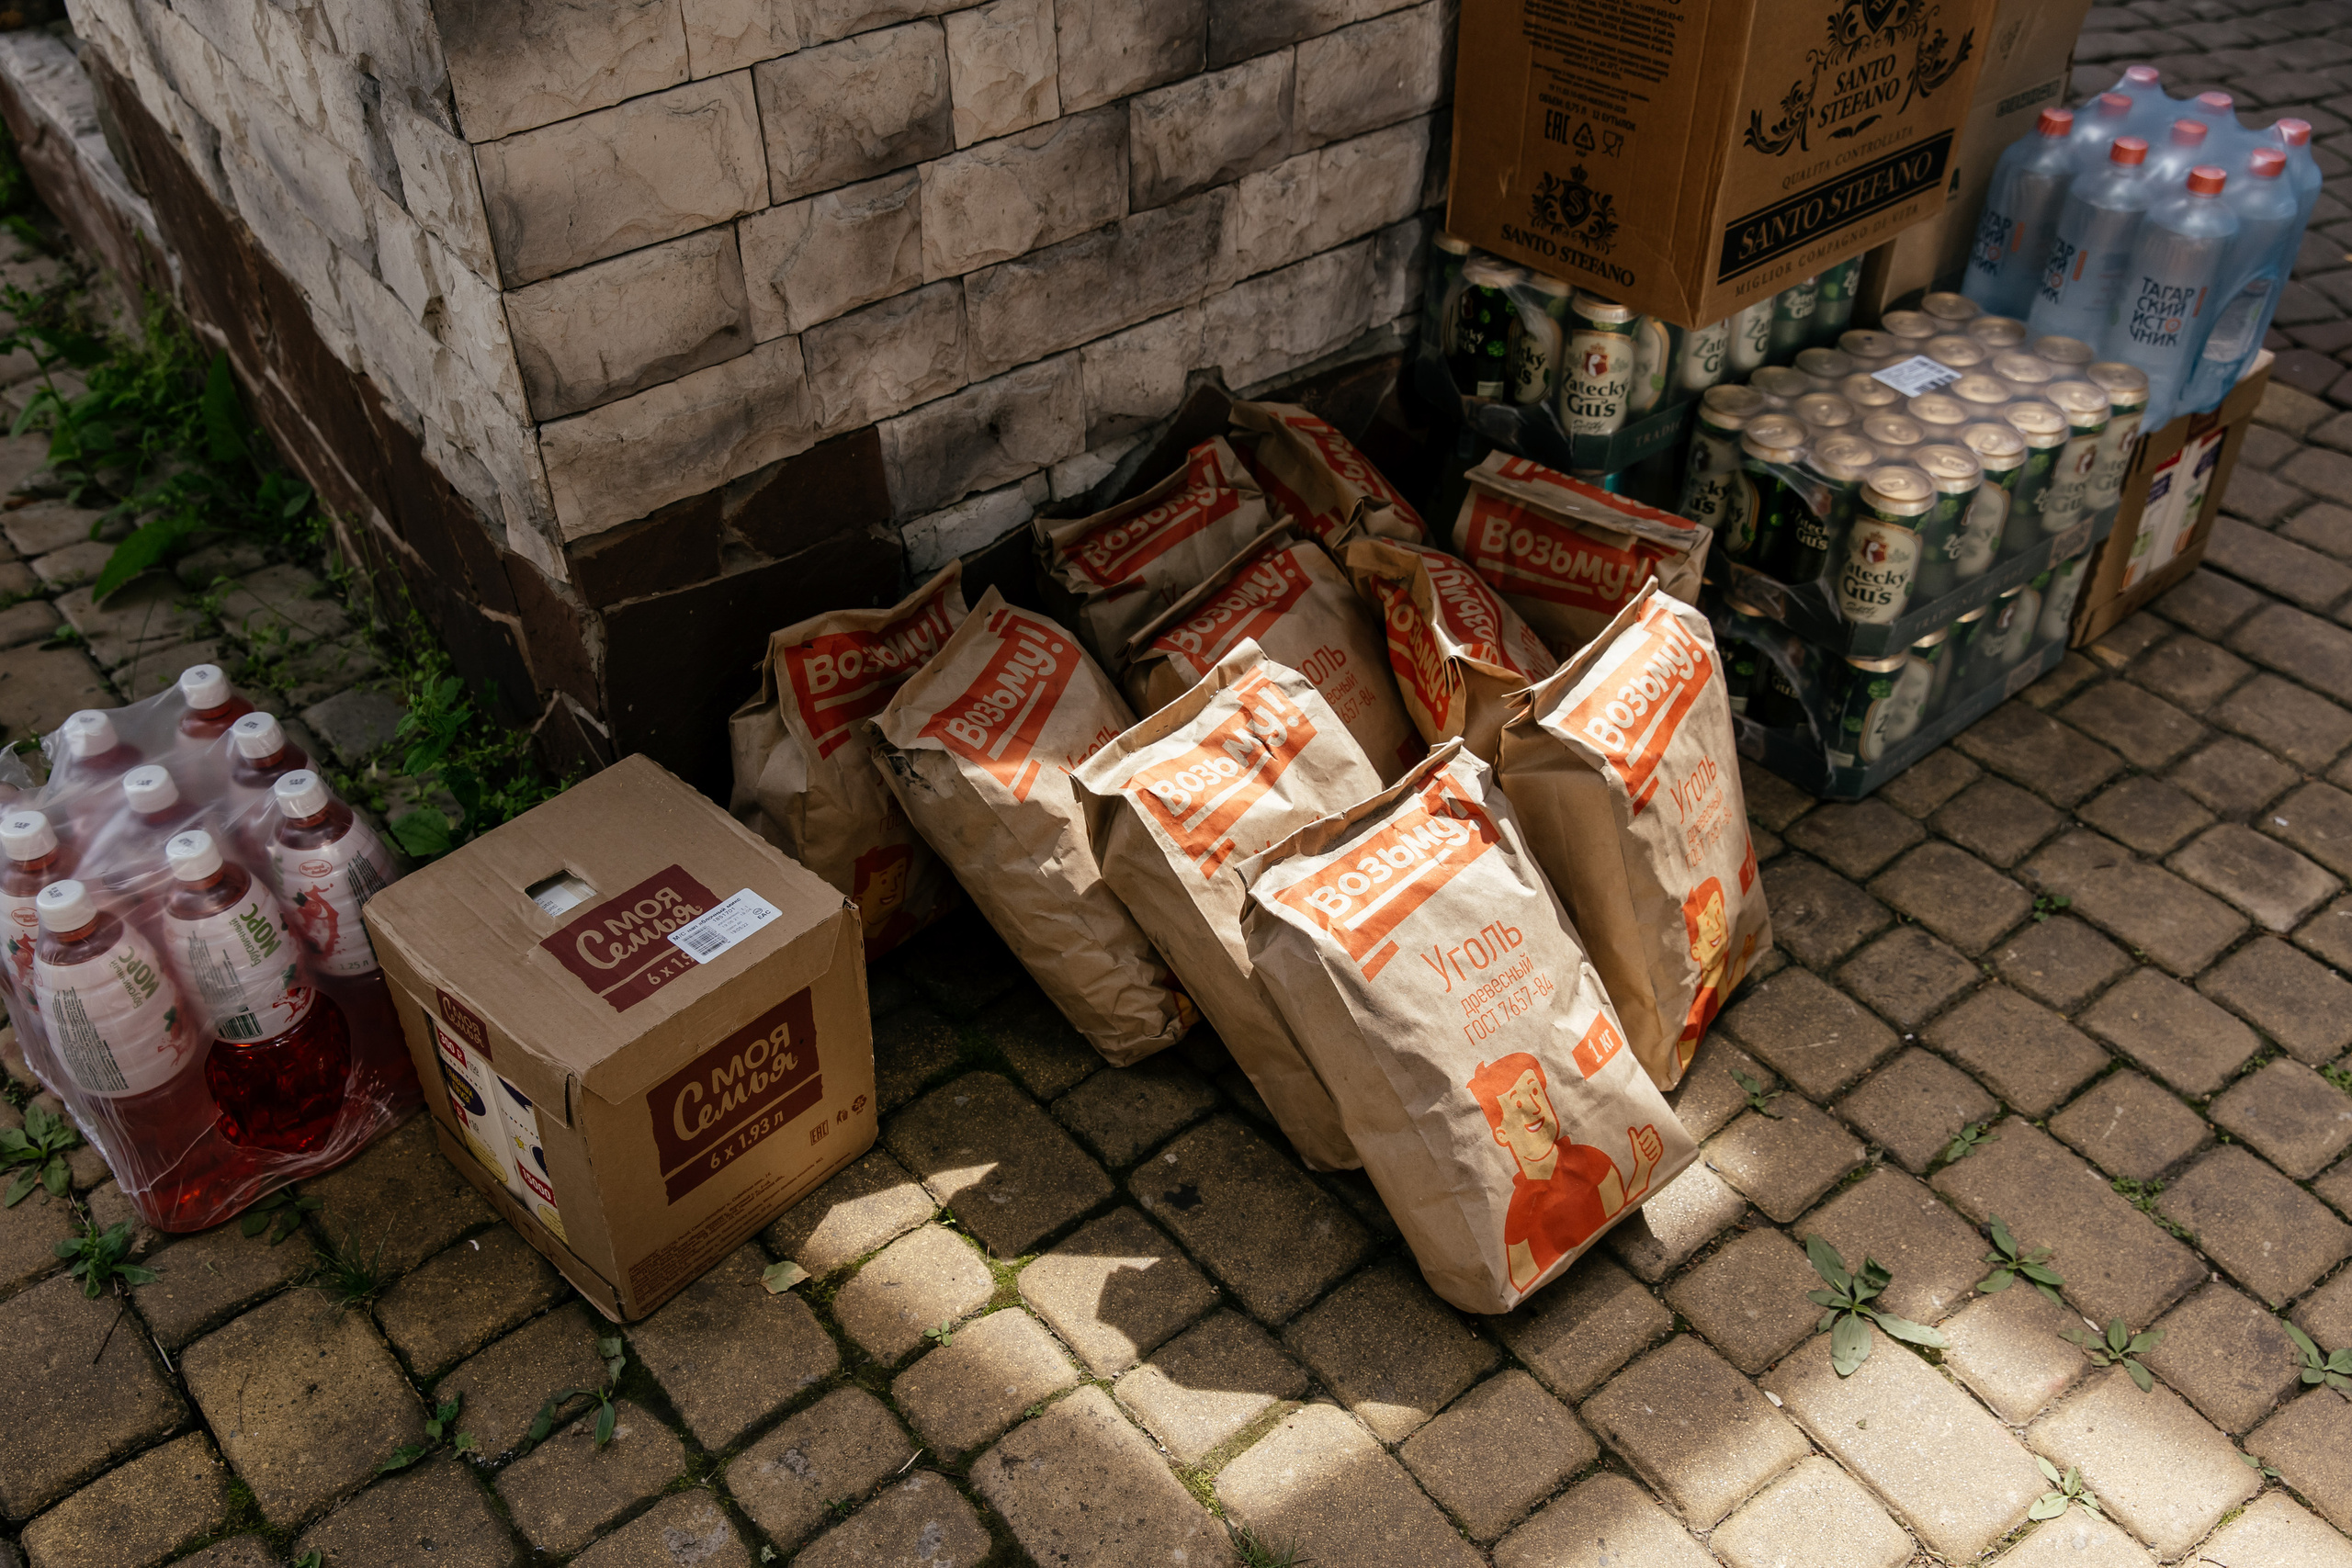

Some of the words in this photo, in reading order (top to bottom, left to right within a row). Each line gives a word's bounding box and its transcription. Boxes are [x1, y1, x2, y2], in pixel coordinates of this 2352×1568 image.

[1834, 54, 1896, 96] SANTO
[1817, 77, 1900, 129] STEFANO
[1737, 197, 1824, 260] SANTO
[1826, 151, 1933, 220] STEFANO
[1501, 223, 1556, 256] SANTO
[1559, 245, 1635, 287] STEFANO
[1735, 259, 1792, 298] MIGLIOR
[1798, 226, 1868, 267] COMPAGNO
[1892, 204, 1918, 224] VITA
[2137, 295, 2187, 318] СКИЙ
[2143, 276, 2196, 301] ТАГАР
[2128, 324, 2179, 347] ЧНИК
[2132, 310, 2182, 333] ИСТО
[1567, 393, 1617, 417] Gus
[1479, 515, 1650, 603] Возьму!
[1843, 575, 1893, 605] Gus
[944, 624, 1064, 750] Возьму!
[1335, 686, 1377, 724] 657-84
[1582, 617, 1703, 753] Возьму!
[1150, 686, 1300, 818] Возьму!
[1669, 756, 1717, 825] Уголь
[1304, 785, 1482, 919] Возьму!
[1685, 837, 1706, 872] ГОСТ
[240, 902, 283, 959] МОРС
[576, 903, 703, 970] Семья
[604, 886, 683, 936] МОЯ
[229, 917, 262, 968] Брусничный
[1420, 919, 1523, 993] Уголь
[119, 945, 160, 999] МОРС
[647, 973, 662, 985] 6
[1461, 953, 1534, 1018] древесный
[442, 997, 484, 1048] Семья
[453, 1006, 481, 1036] МОЯ
[1463, 1008, 1504, 1046] ГОСТ
[1501, 973, 1555, 1030] 7657-84
[711, 1021, 791, 1095] МОЯ
[1588, 1041, 1602, 1064] 1
[1599, 1028, 1614, 1055] кг
[673, 1053, 798, 1141] Семья
[709, 1152, 721, 1169] 6
[738, 1117, 771, 1149] 1.93
[774, 1111, 784, 1127] л
[810, 1122, 828, 1145] EAC
[522, 1168, 551, 1201] 15000
